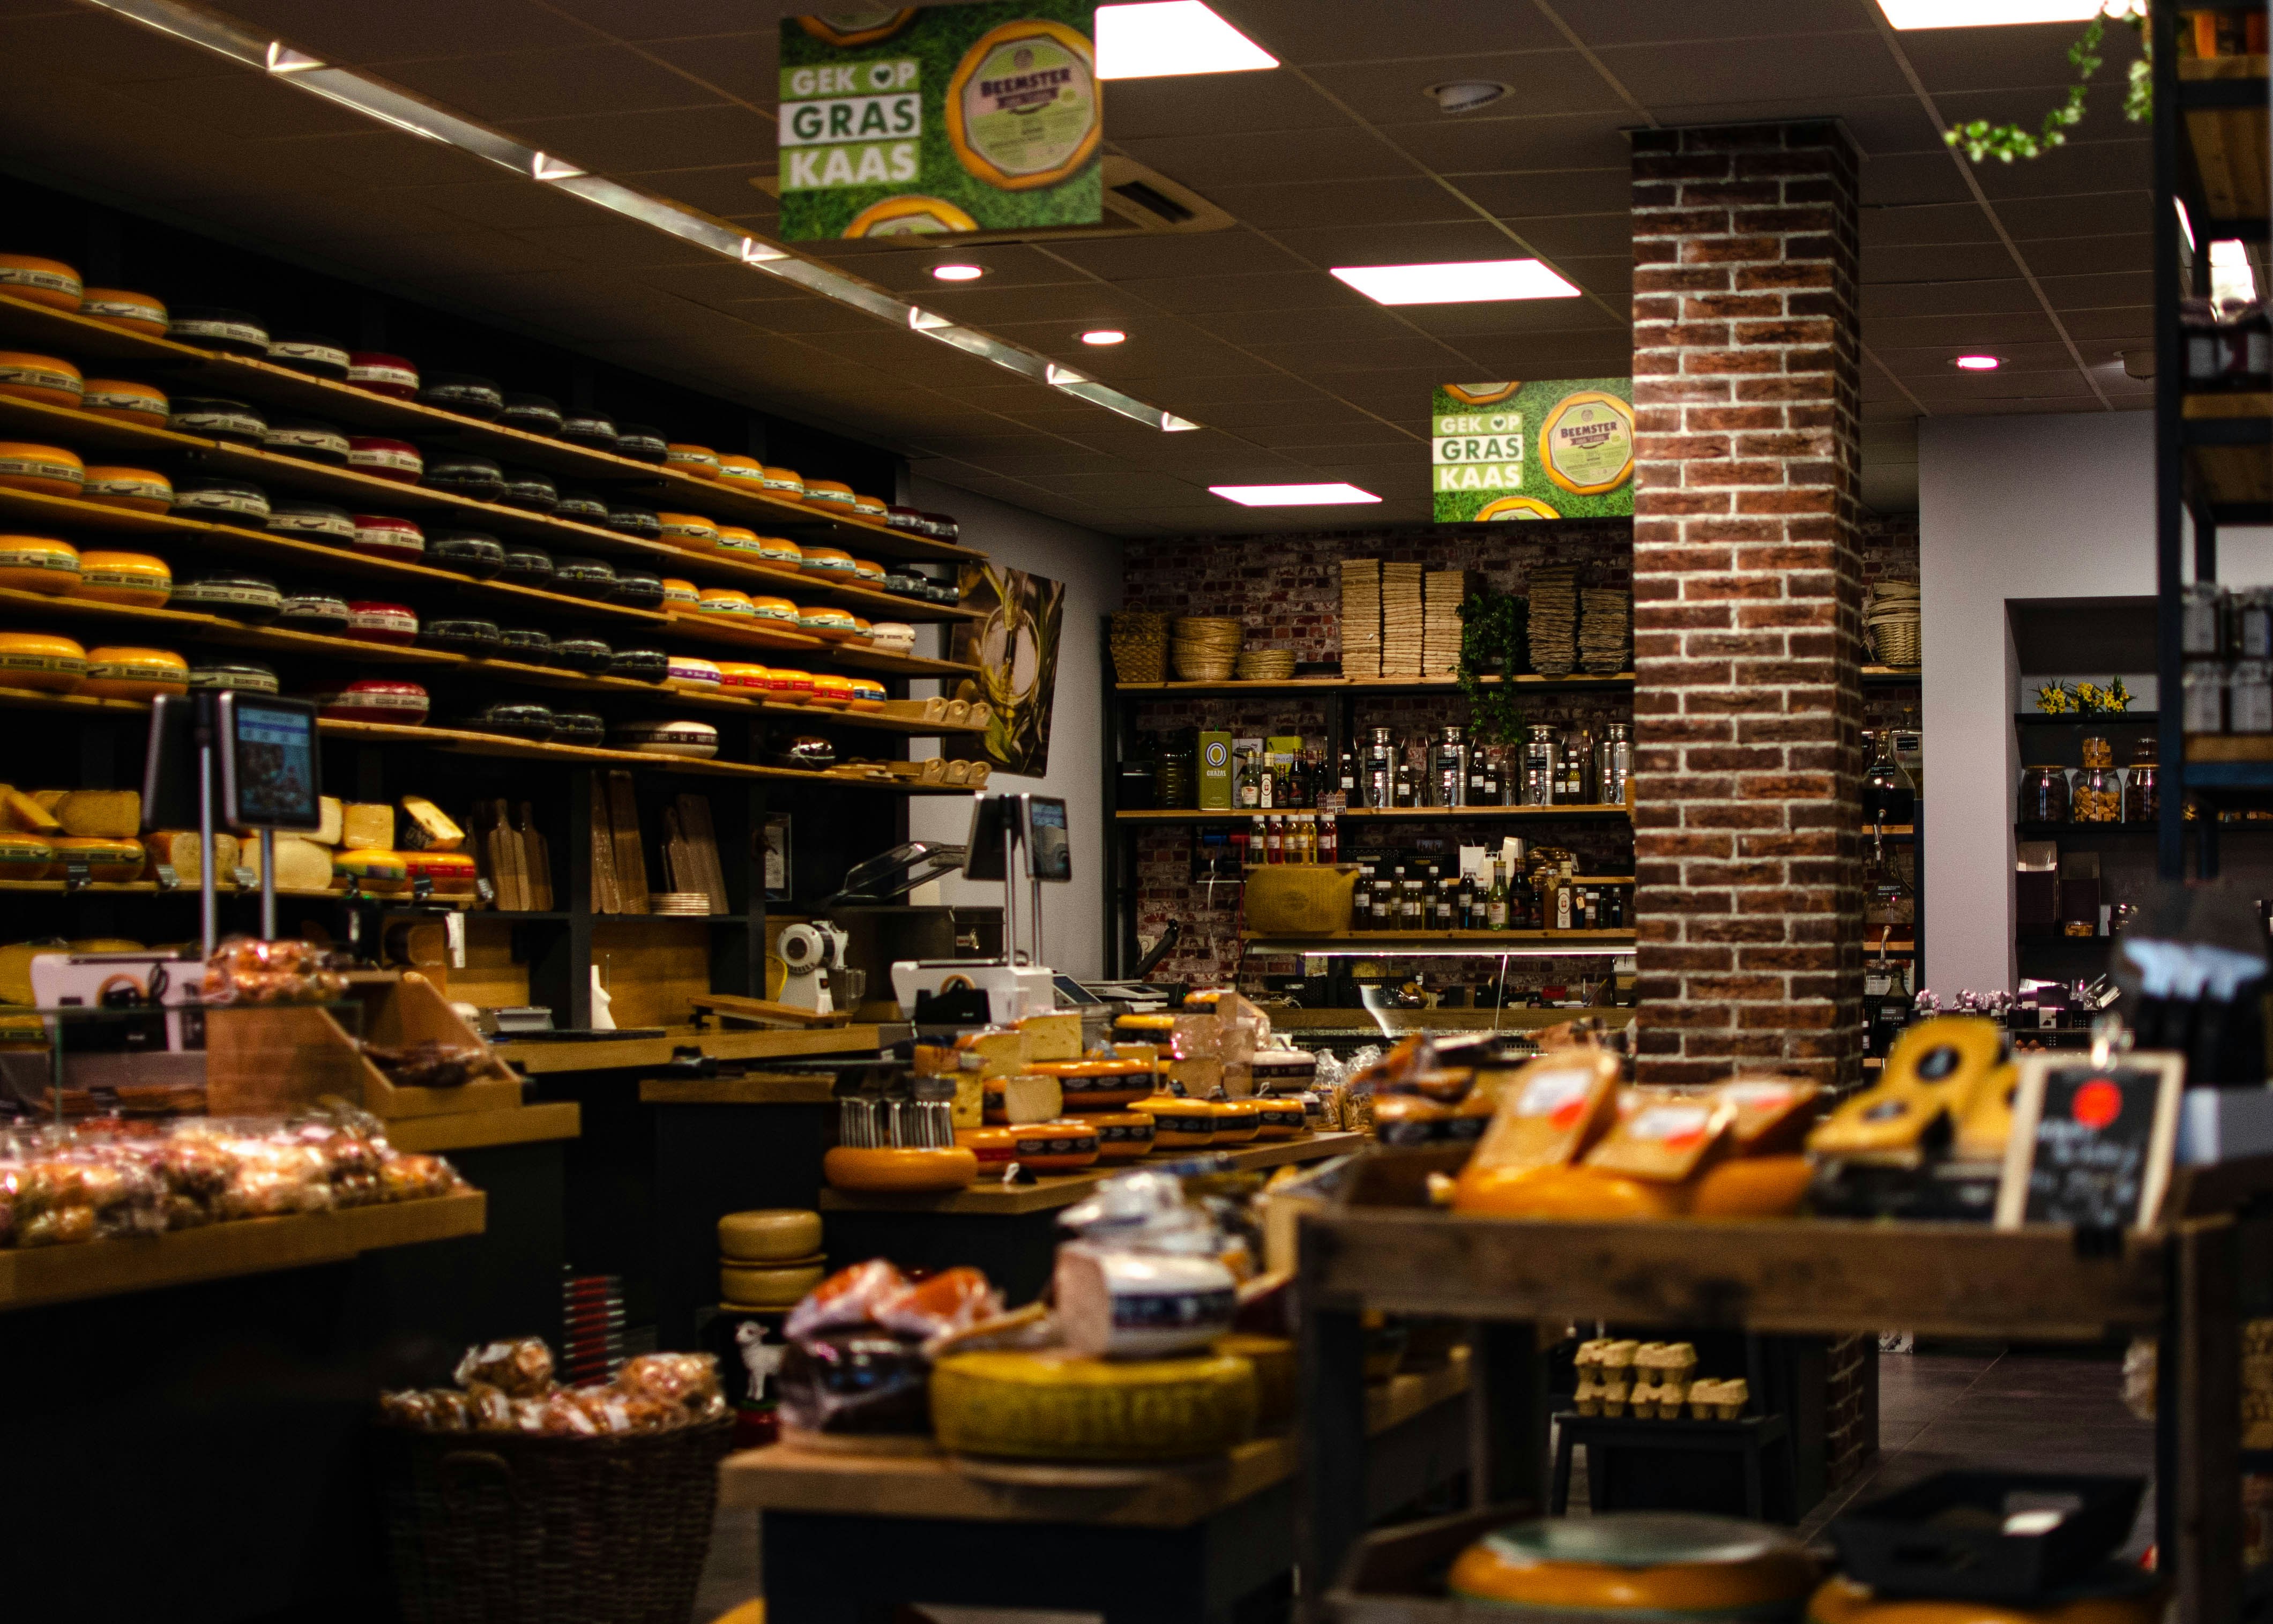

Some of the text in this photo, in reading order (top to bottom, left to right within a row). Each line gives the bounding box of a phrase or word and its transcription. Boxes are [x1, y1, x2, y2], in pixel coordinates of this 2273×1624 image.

[791, 61, 916, 95] GEK OP
[981, 68, 1071, 97] BEEMSTER
[793, 98, 915, 139] GRAS
[790, 143, 916, 188] KAAS
[1440, 414, 1520, 434] GEK OP
[1560, 421, 1618, 438] BEEMSTER
[1441, 437, 1520, 460] GRAS
[1440, 465, 1521, 490] KAAS
